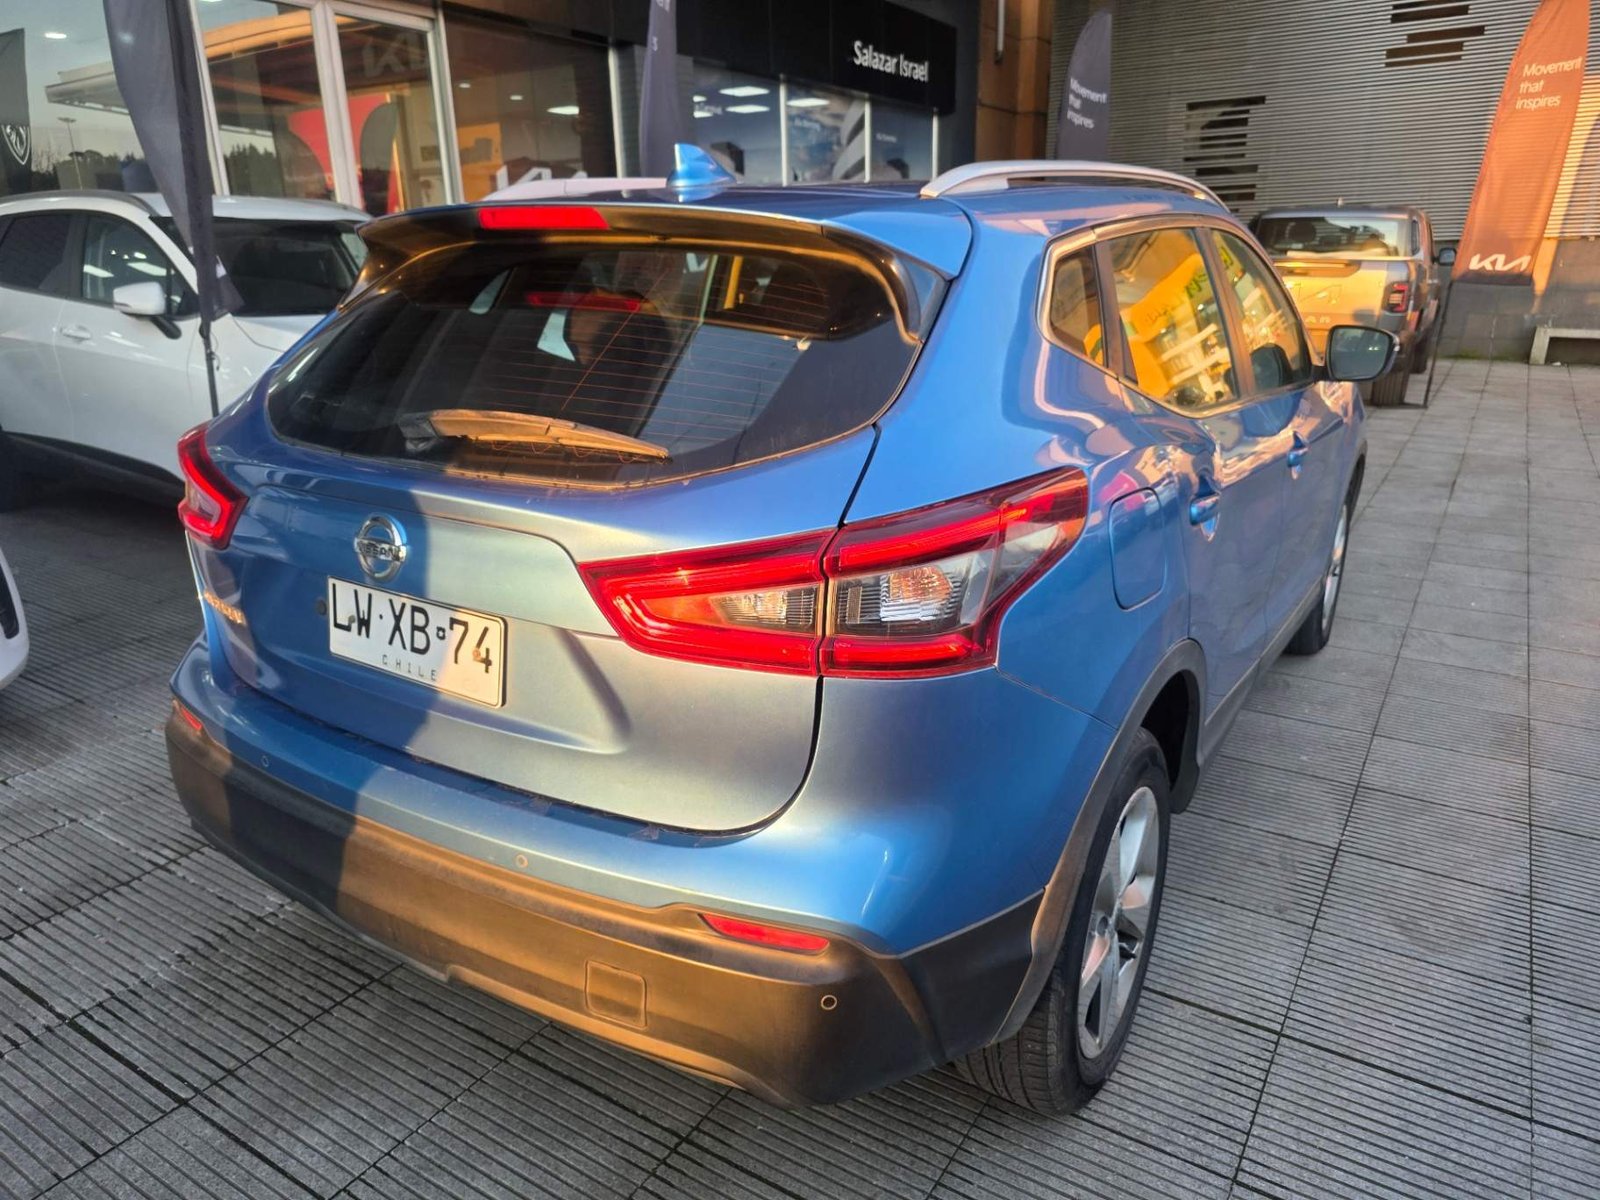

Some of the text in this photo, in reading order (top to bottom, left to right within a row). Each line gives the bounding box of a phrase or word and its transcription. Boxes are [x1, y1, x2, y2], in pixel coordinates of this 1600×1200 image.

[853, 39, 929, 82] Salazar Israel
[1522, 56, 1583, 77] Movement
[1519, 79, 1544, 94] that
[1515, 95, 1561, 111] inspires
[1468, 253, 1532, 272] KIA
[382, 654, 437, 682] CHILE
